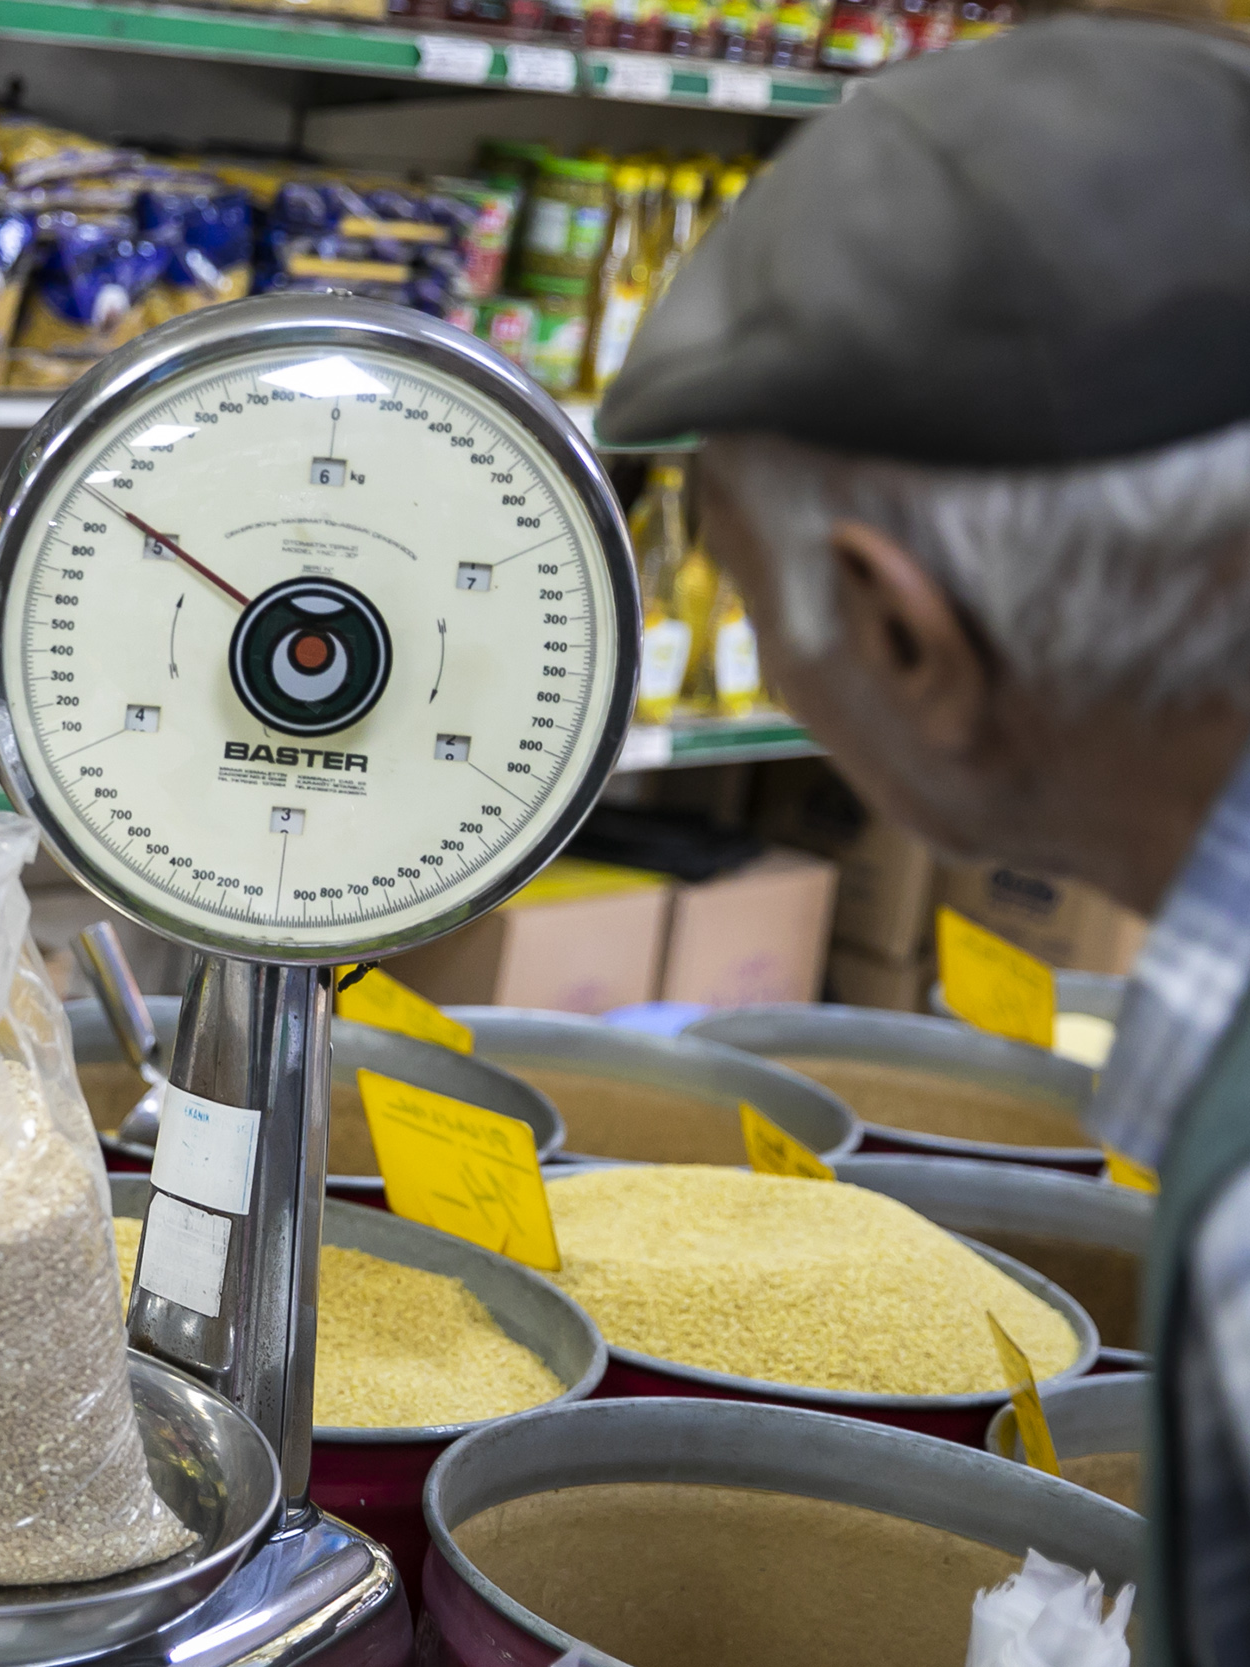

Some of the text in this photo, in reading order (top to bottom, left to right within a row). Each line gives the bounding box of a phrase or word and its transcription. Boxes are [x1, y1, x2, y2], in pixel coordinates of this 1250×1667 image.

[246, 393, 269, 406] 700
[272, 390, 295, 401] 800
[219, 402, 243, 414] 600
[380, 400, 403, 412] 200
[195, 412, 218, 424] 500
[404, 409, 428, 420] 300
[428, 422, 452, 434] 400
[450, 437, 474, 448] 500
[131, 459, 154, 471] 200
[470, 454, 494, 465] 600
[319, 469, 365, 484] 6 kg
[490, 472, 513, 484] 700
[113, 478, 133, 489] 100
[502, 495, 526, 506] 800
[83, 522, 107, 534] 900
[517, 517, 540, 529] 900
[71, 545, 95, 557] 800
[152, 540, 163, 556] 5
[62, 569, 84, 580] 700
[538, 564, 559, 575] 100
[466, 577, 477, 590] 7
[55, 594, 79, 606] 600
[539, 590, 563, 601] 200
[51, 619, 75, 631] 500
[543, 614, 568, 625] 300
[50, 645, 74, 656] 400
[543, 641, 568, 653] 400
[50, 671, 74, 682] 300
[542, 666, 567, 678] 500
[56, 695, 79, 706] 200
[537, 692, 561, 703] 600
[135, 708, 145, 722] 4
[62, 721, 82, 732] 100
[531, 716, 554, 728] 700
[519, 740, 543, 752] 800
[224, 741, 368, 773] BASTER
[80, 766, 103, 777] 900
[507, 762, 531, 774] 900
[94, 788, 118, 799] 800
[110, 809, 132, 820] 700
[281, 808, 291, 821] 3
[481, 805, 502, 817] 100
[127, 827, 151, 837] 600
[459, 822, 483, 834] 200
[146, 844, 170, 855] 500
[440, 840, 464, 852] 300
[169, 857, 192, 868] 400
[420, 855, 443, 866] 400
[192, 870, 216, 881] 300
[397, 868, 421, 880] 500
[217, 877, 240, 889] 200
[372, 876, 395, 888] 600
[243, 885, 263, 896] 100
[293, 890, 316, 902] 900
[320, 888, 343, 899] 800
[347, 884, 369, 896] 700
